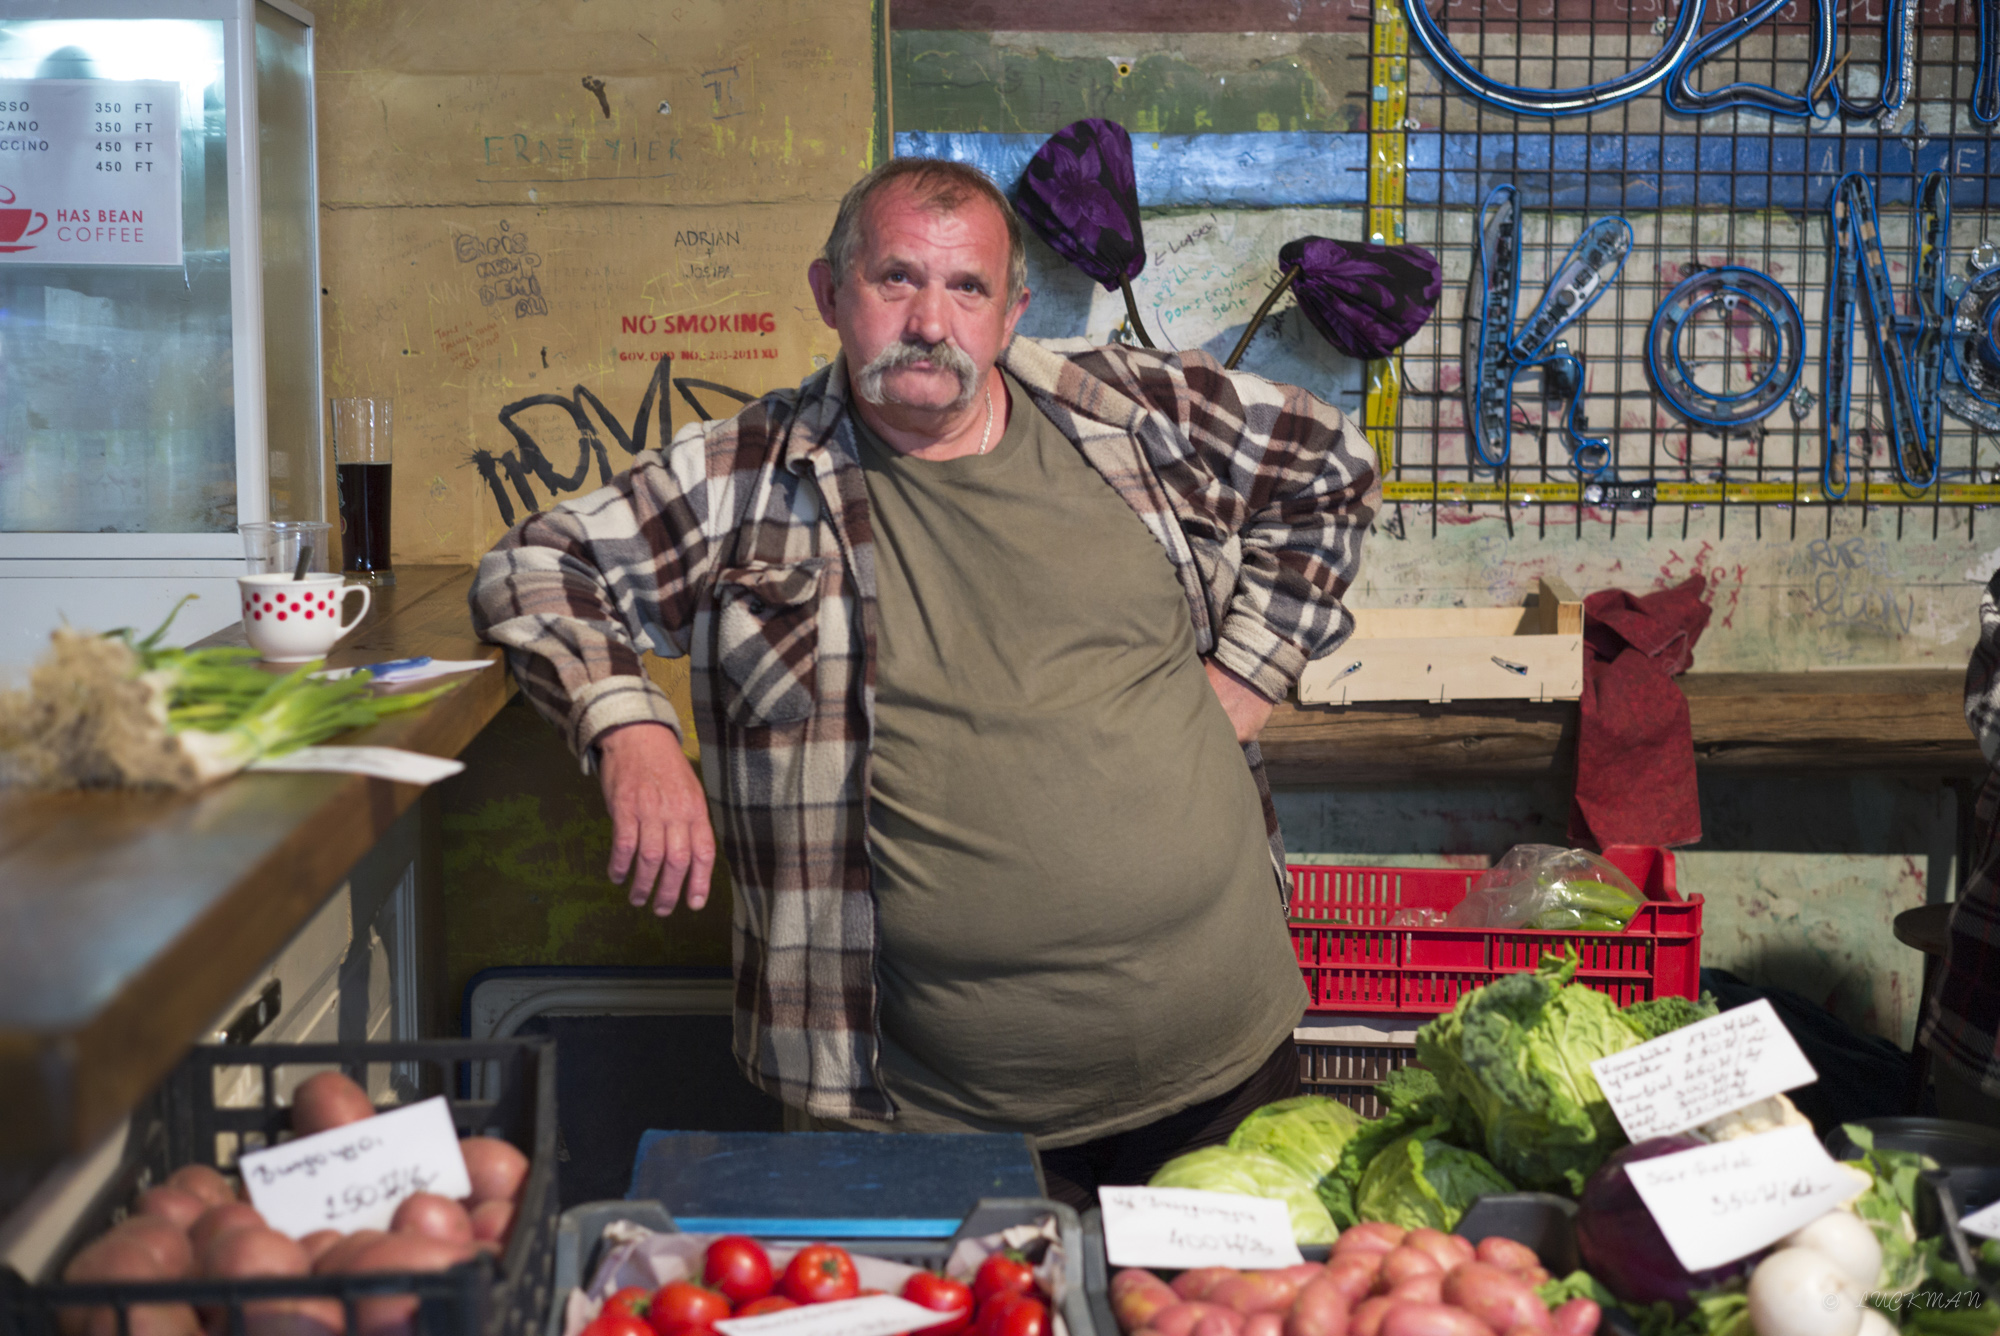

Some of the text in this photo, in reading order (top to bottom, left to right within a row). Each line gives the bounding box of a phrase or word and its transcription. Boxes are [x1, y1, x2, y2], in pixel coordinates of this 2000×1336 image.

[95, 103, 121, 113] 350
[135, 103, 153, 113] FT
[95, 123, 121, 133] 350
[135, 123, 153, 133] FT
[95, 142, 122, 152] 450
[135, 142, 153, 152] FT
[95, 162, 153, 172] 450 FT
[57, 209, 143, 223] HAS BEAN
[57, 226, 144, 243] COFFEE
[621, 312, 776, 334] NO SMOKING
